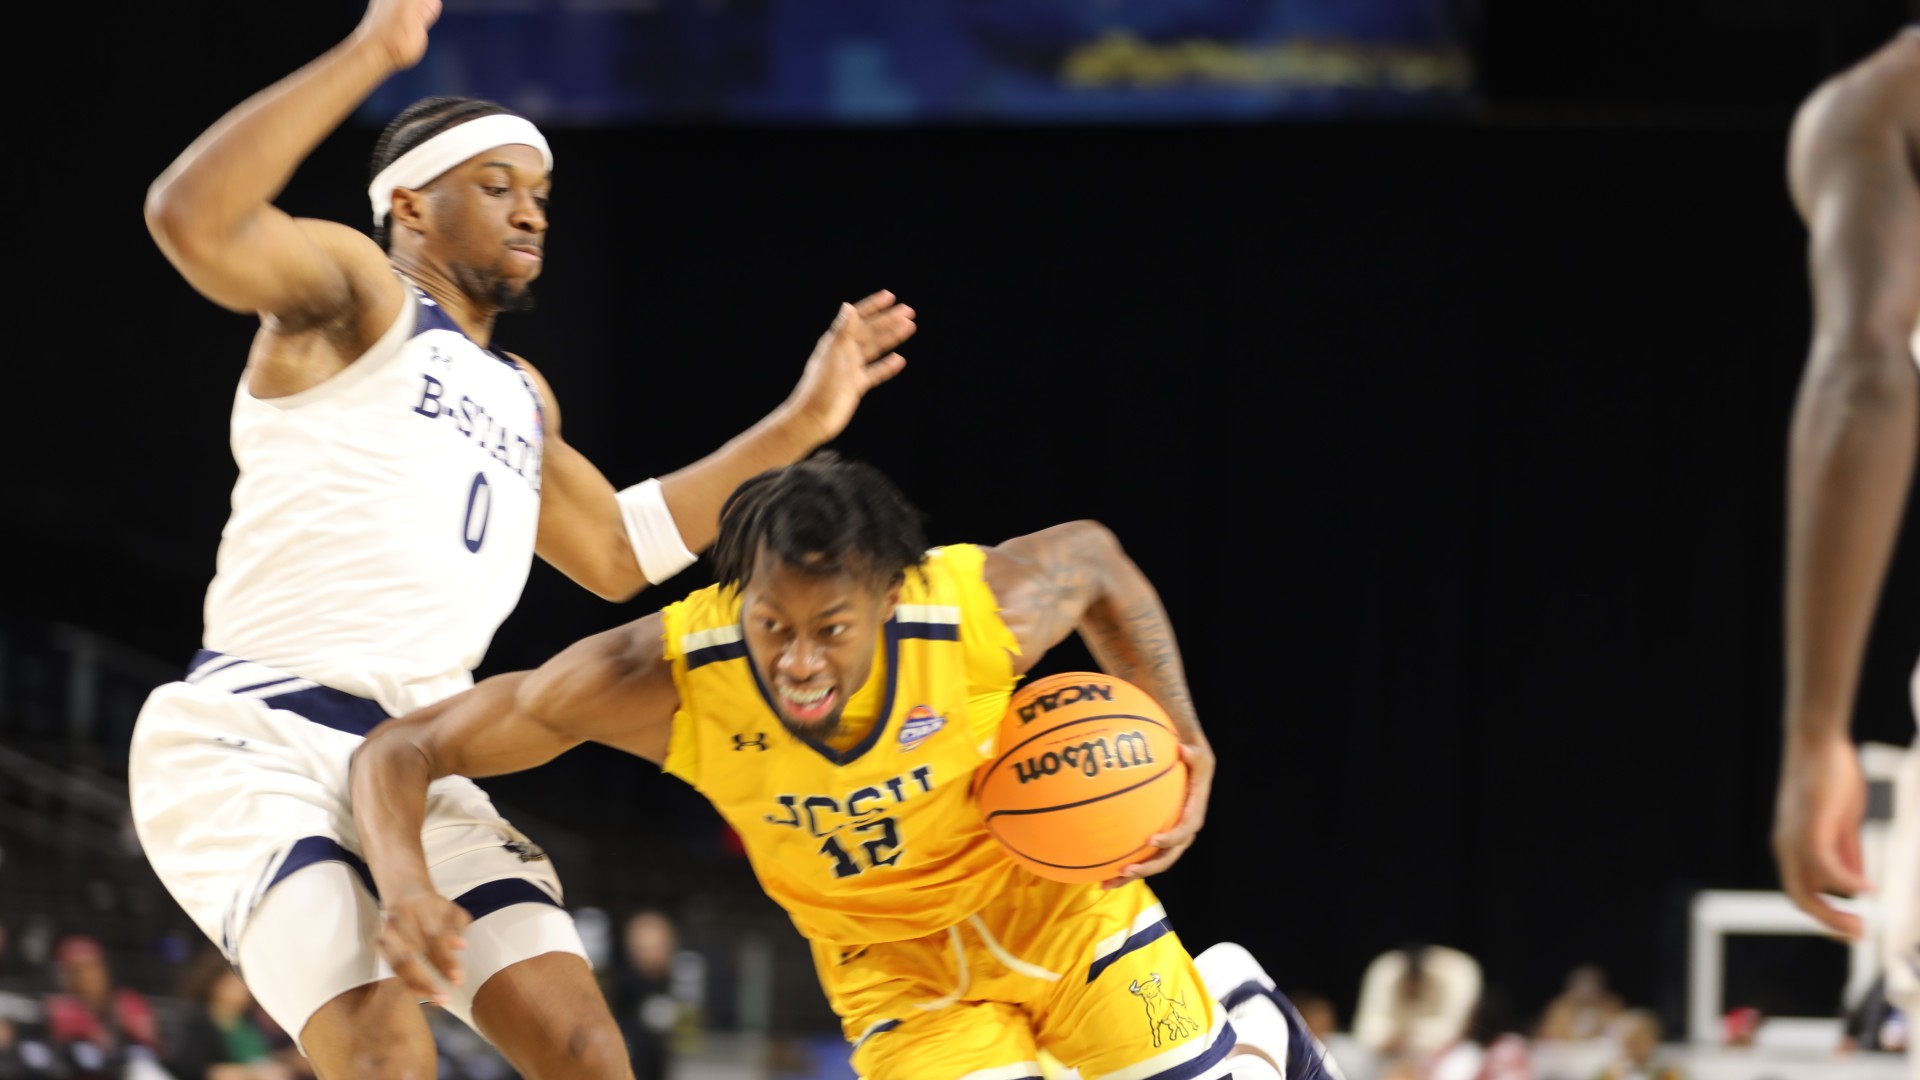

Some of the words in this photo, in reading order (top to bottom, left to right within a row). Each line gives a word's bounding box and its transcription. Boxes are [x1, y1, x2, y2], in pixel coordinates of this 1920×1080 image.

[463, 471, 491, 554] 0
[1016, 683, 1114, 725] NCAA
[1012, 731, 1153, 784] Wilson
[819, 817, 904, 878] 12
